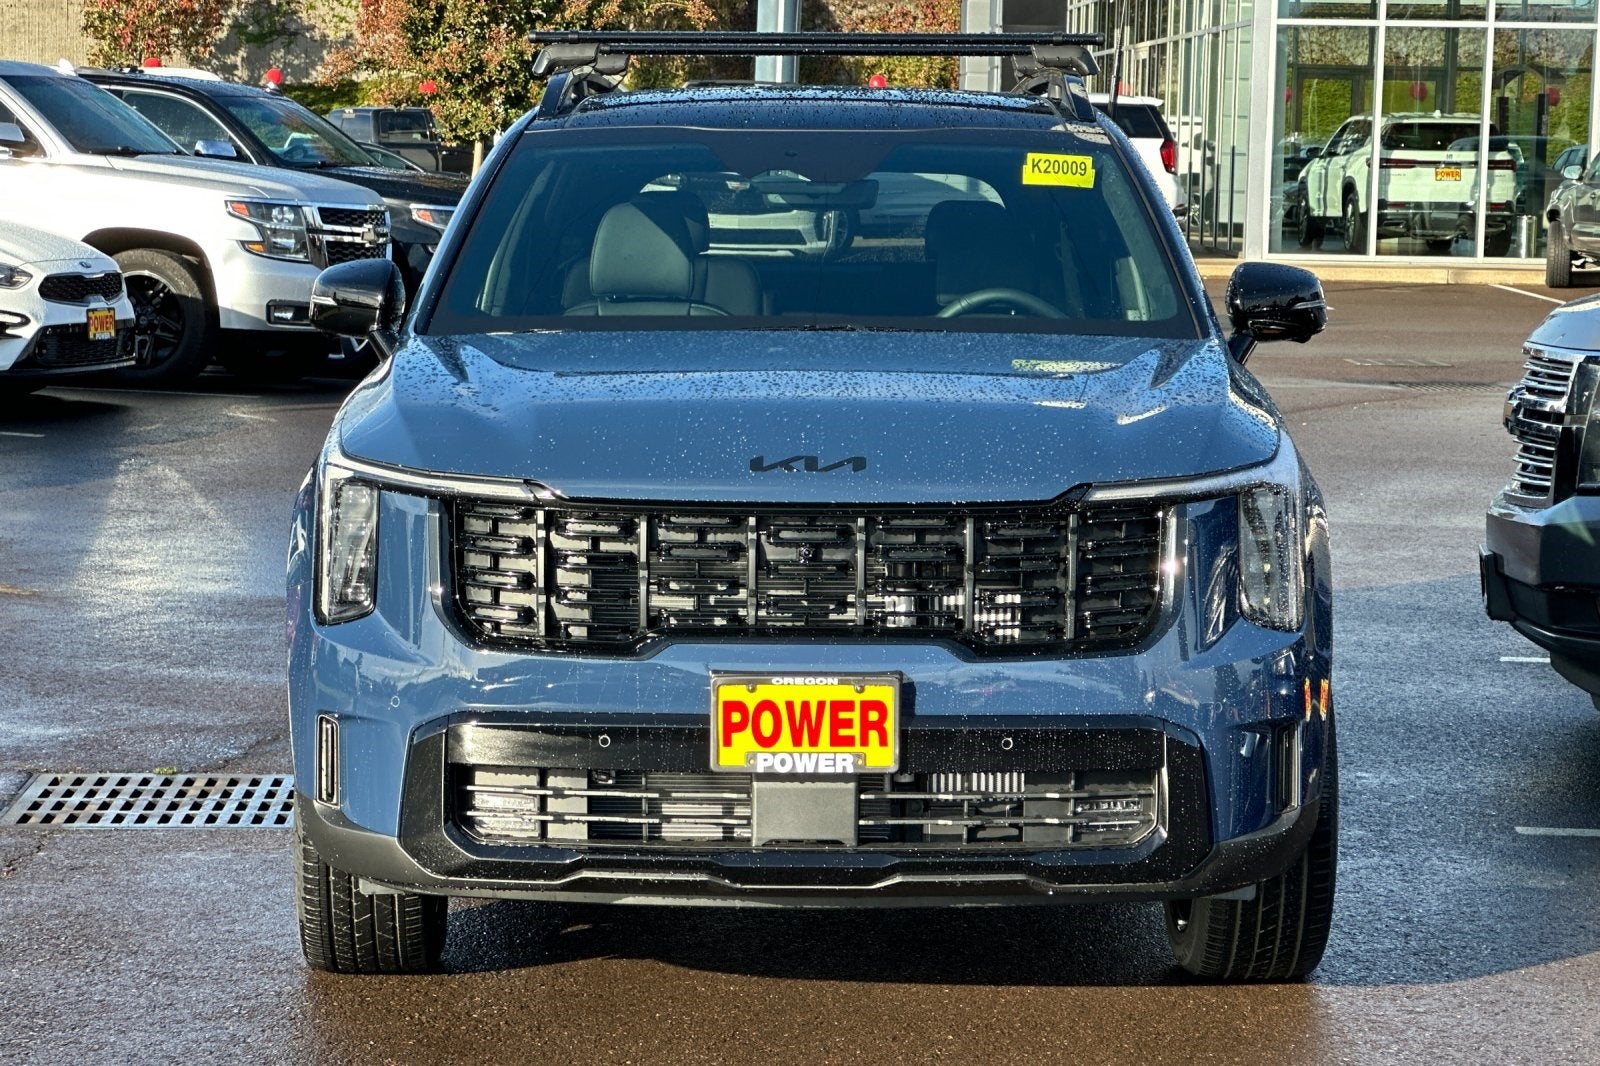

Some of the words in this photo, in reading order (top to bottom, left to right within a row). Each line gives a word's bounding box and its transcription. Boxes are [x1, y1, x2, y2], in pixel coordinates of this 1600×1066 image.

[1031, 158, 1087, 176] K20009
[1436, 170, 1460, 178] POWER
[88, 314, 114, 332] POWER
[771, 677, 839, 686] OREGON
[722, 699, 888, 748] POWER
[756, 753, 854, 773] POWER
